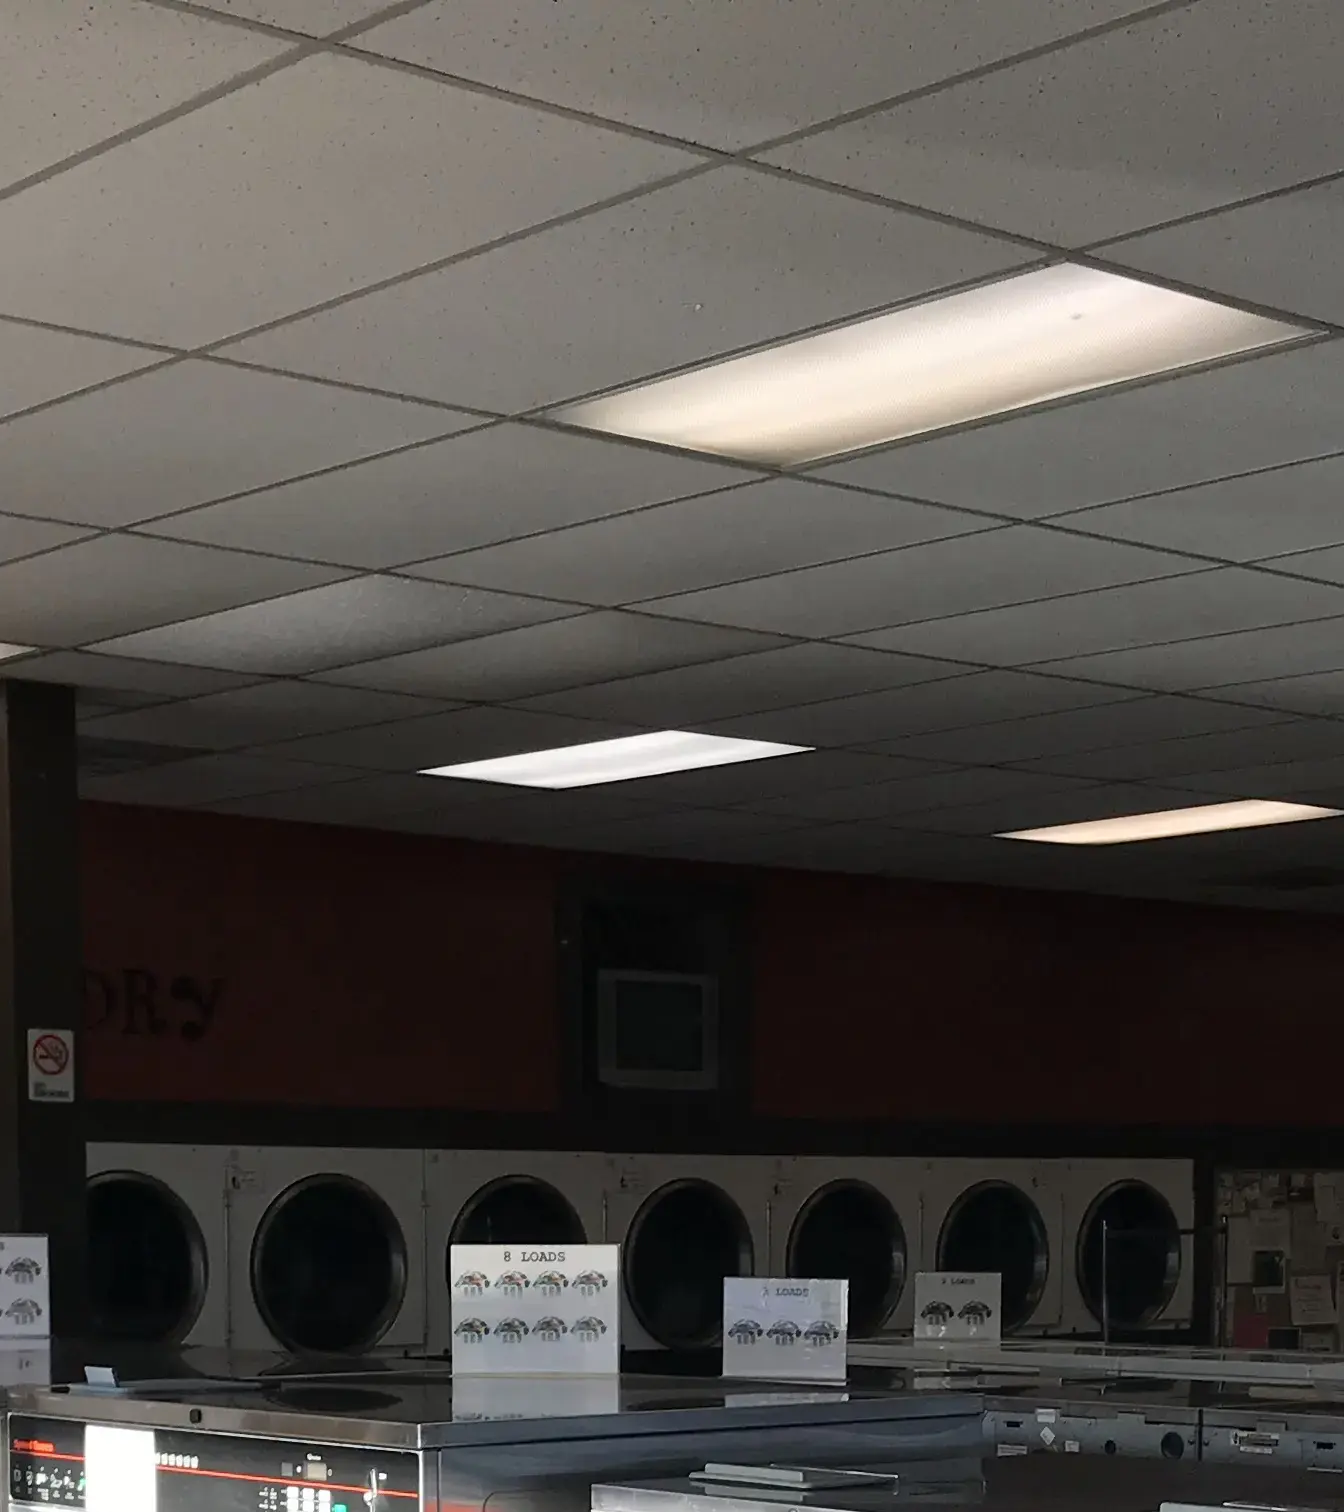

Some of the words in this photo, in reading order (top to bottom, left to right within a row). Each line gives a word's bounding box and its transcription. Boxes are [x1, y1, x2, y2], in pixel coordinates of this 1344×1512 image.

[503, 1251, 512, 1262] 8
[521, 1251, 566, 1262] LOADS
[775, 1287, 810, 1297] LOADS
